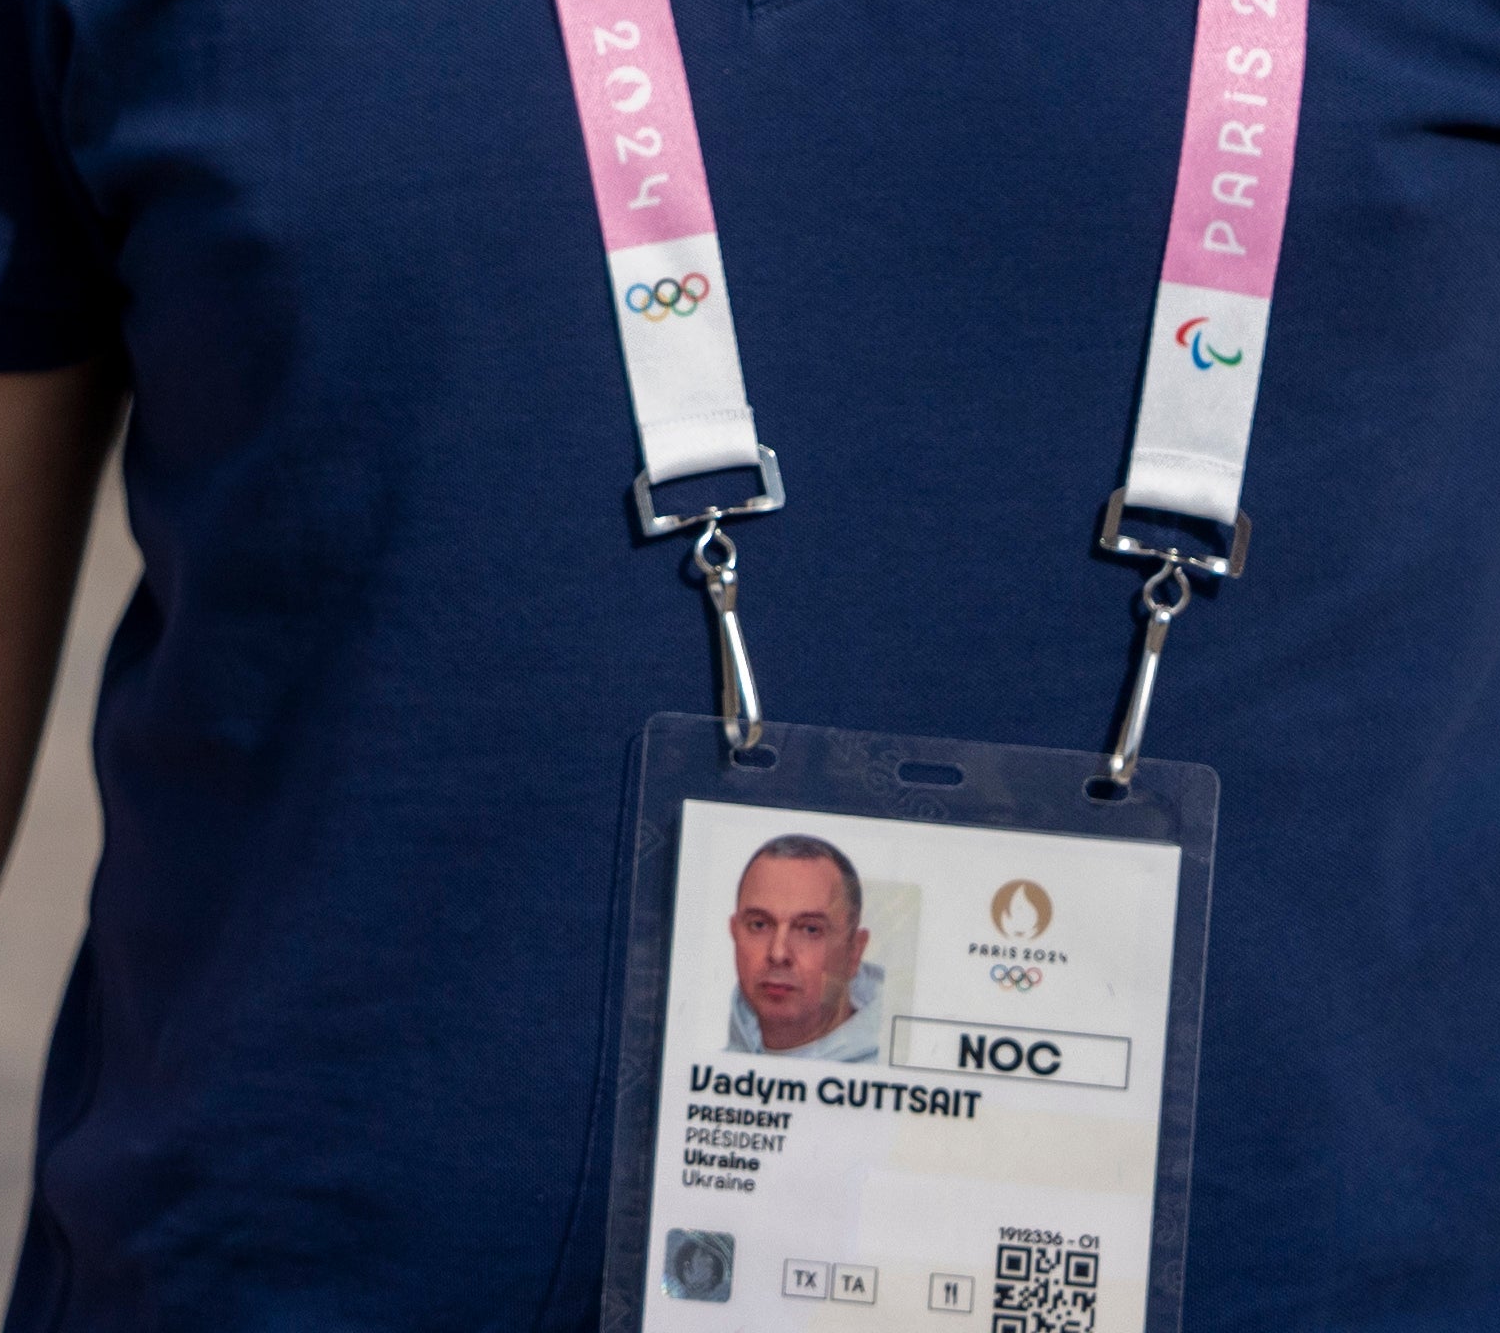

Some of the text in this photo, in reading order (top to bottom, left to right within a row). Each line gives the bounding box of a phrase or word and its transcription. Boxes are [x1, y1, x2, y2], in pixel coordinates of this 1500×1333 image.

[592, 19, 669, 211] 2024
[1022, 947, 1068, 964] 2024
[958, 1033, 1062, 1076] NOC
[689, 1063, 981, 1118] Vadym GUTTSAIT
[686, 1103, 792, 1130] PRESIDENT
[685, 1124, 786, 1152] PRÉSIDENT
[683, 1148, 760, 1171] Ukraine
[681, 1169, 755, 1192] Ukraine
[999, 1226, 1063, 1245] 1912336
[794, 1269, 817, 1287] TX
[842, 1274, 866, 1293] TA
